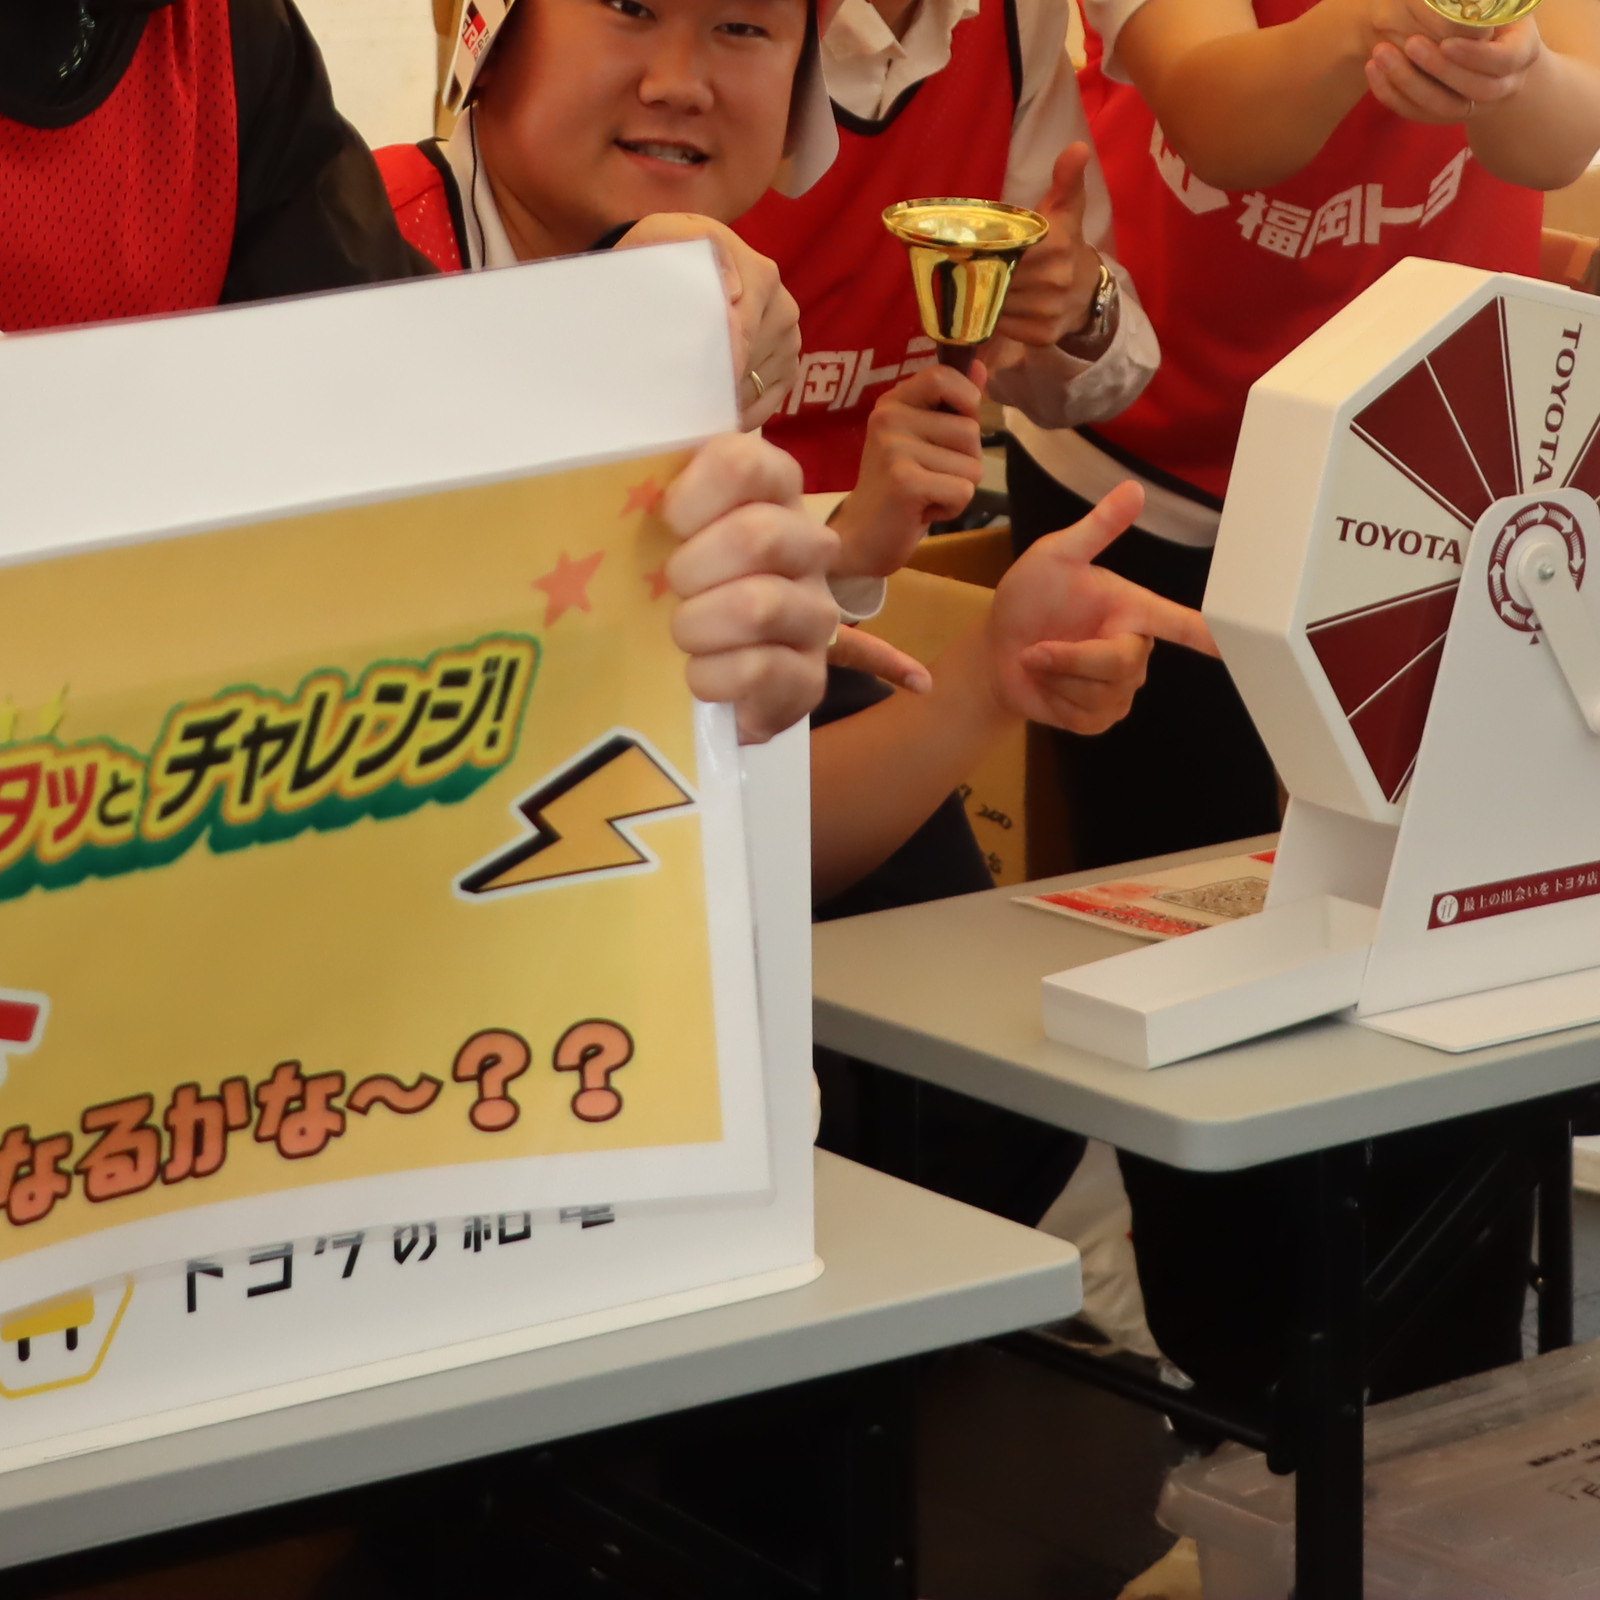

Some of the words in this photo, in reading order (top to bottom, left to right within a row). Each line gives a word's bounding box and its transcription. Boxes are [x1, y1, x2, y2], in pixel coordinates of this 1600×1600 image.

[1236, 145, 1474, 259] 福岡トヨ
[778, 335, 940, 416] 岡ト
[1532, 322, 1584, 485] TOYOTA
[1335, 515, 1463, 565] TOYOTA
